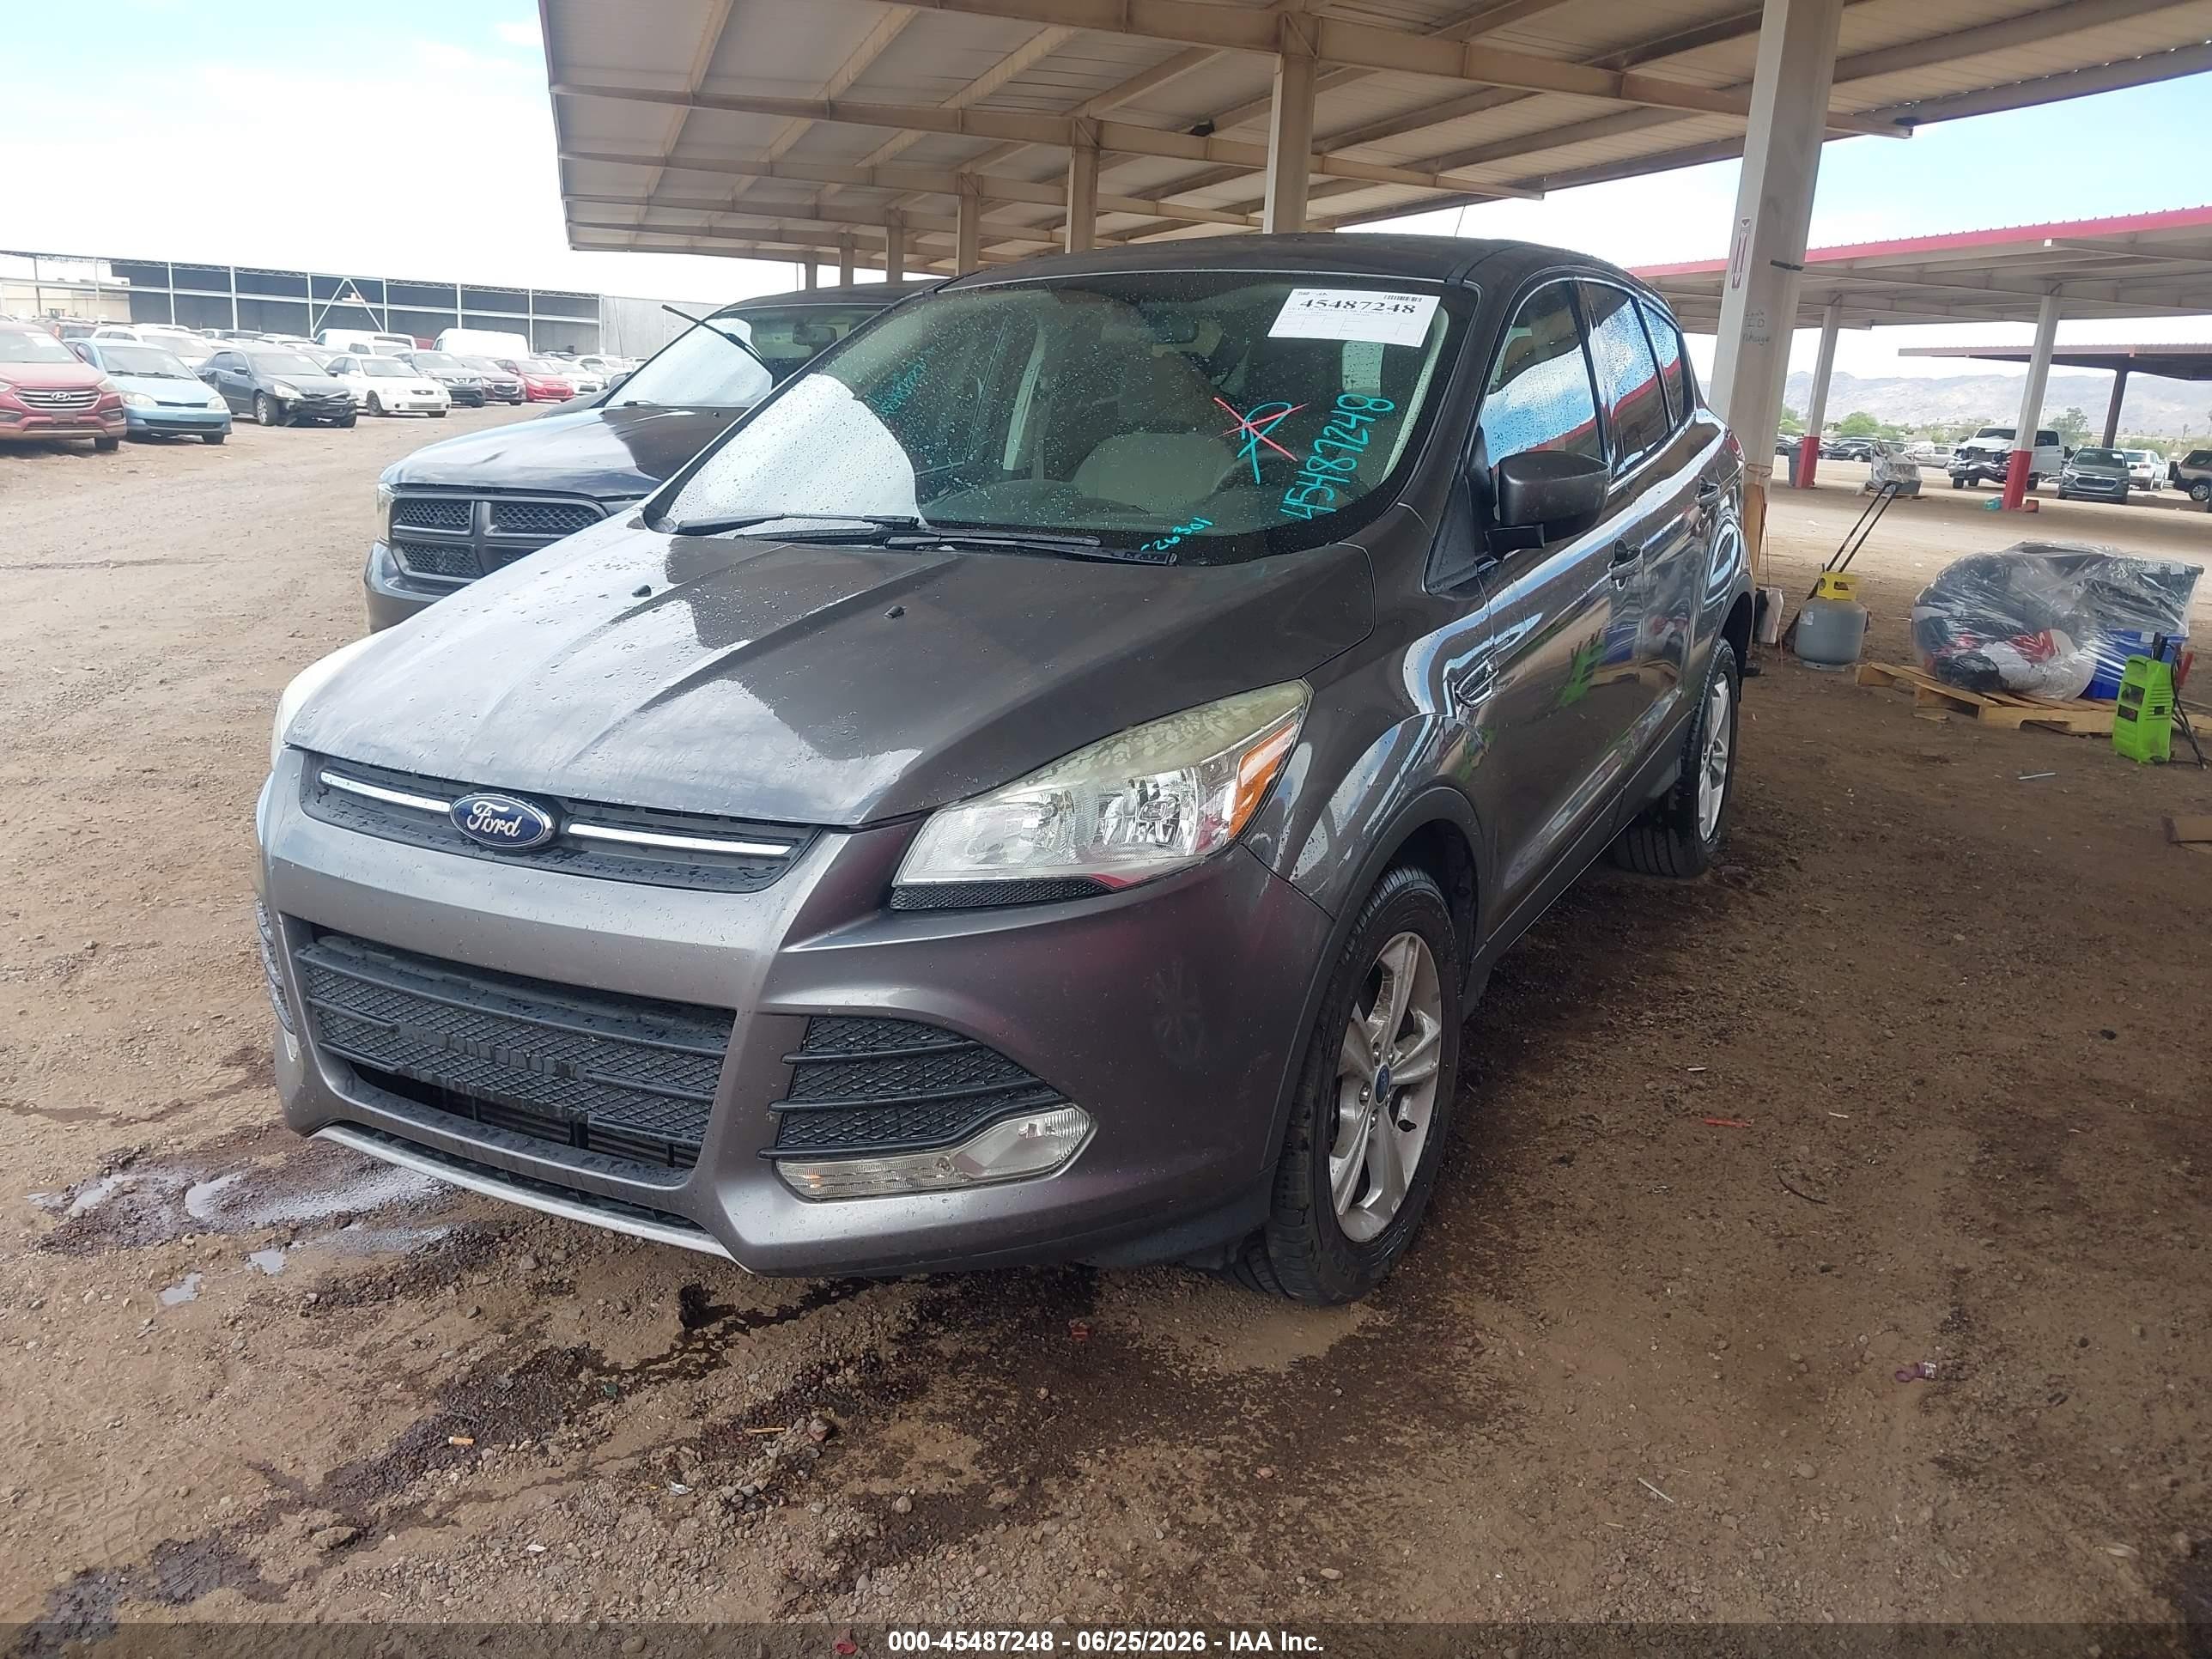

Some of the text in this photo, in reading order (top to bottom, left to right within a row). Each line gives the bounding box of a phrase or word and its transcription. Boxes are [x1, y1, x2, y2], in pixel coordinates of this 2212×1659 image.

[1299, 299, 1416, 314] 45487248
[1279, 392, 1395, 520] 45487248
[466, 800, 521, 838] Ford
